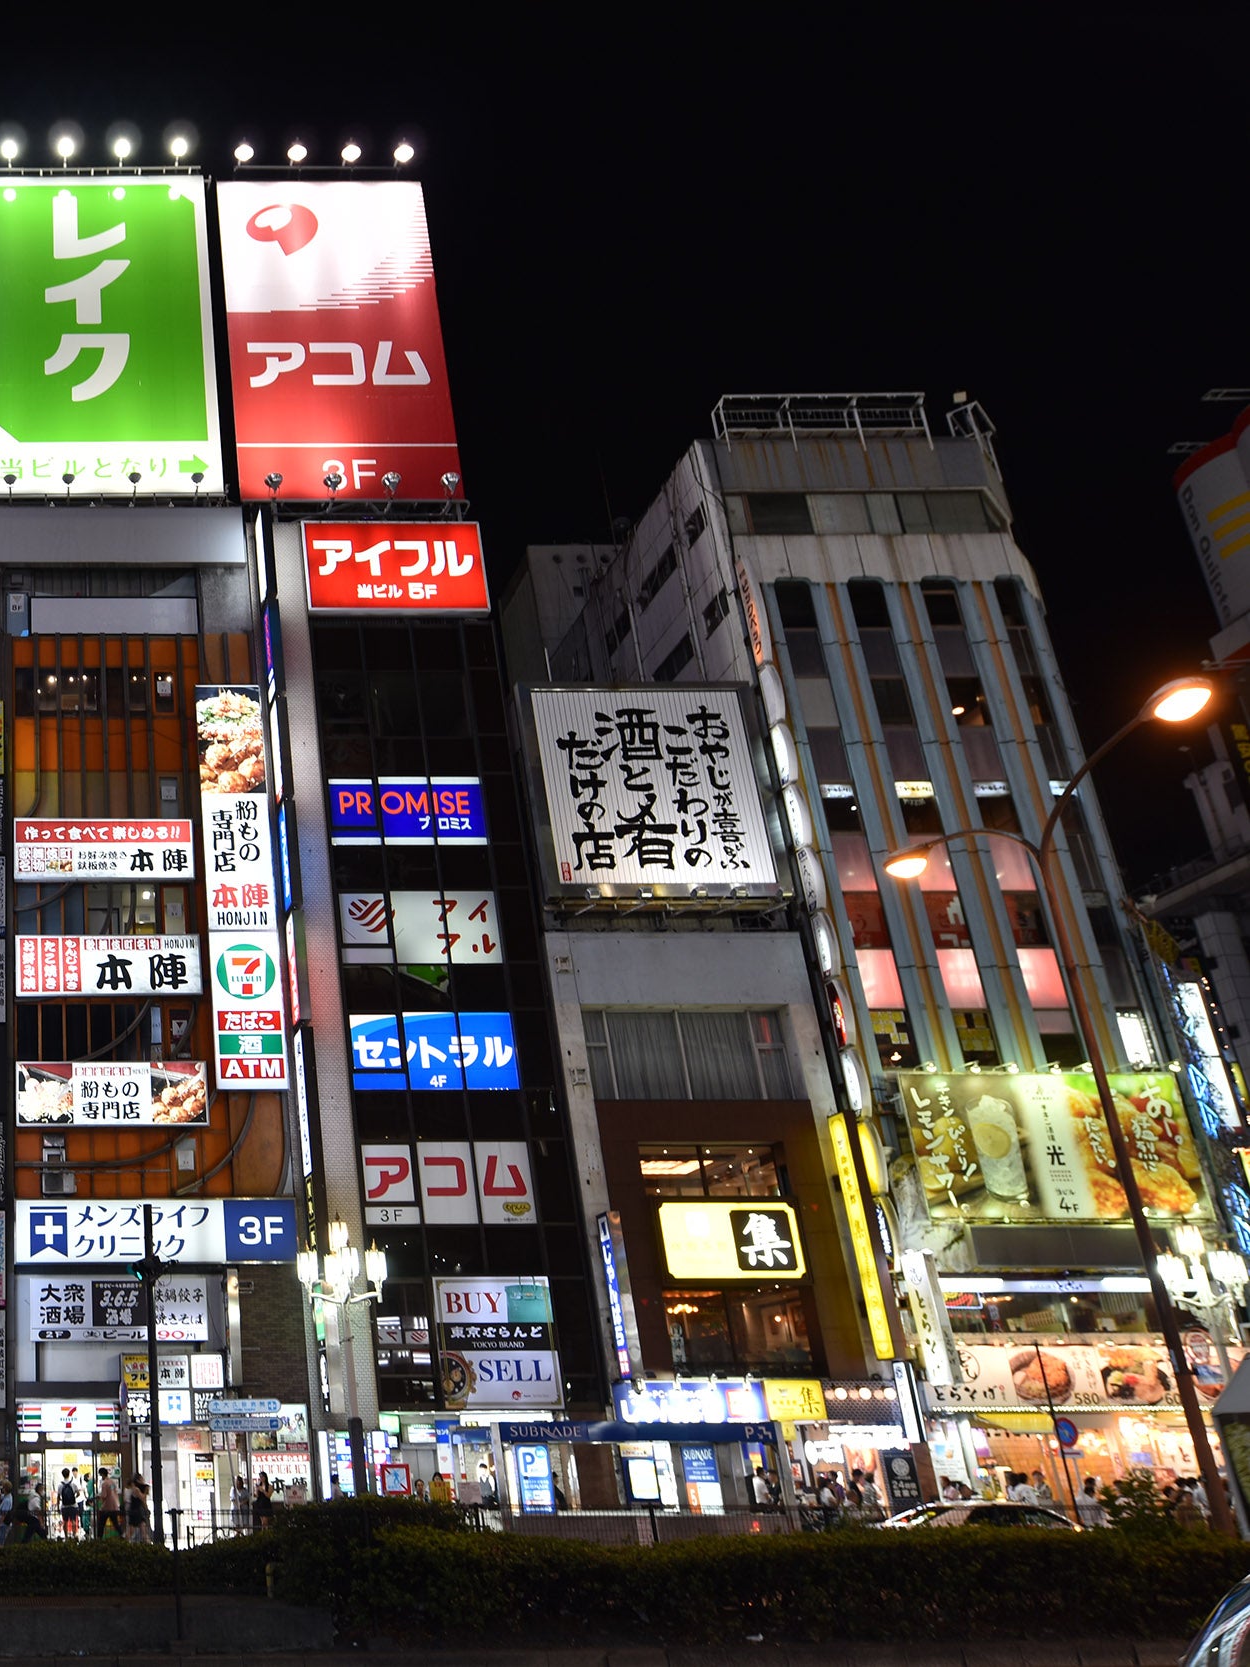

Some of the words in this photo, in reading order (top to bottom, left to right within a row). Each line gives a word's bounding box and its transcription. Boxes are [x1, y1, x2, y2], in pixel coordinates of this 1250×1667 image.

[44, 196, 131, 402] レイク
[247, 341, 431, 388] アコム
[0, 458, 167, 480] 当ビルとなり
[322, 459, 377, 490] 3F
[312, 540, 474, 577] アイフル
[1181, 484, 1205, 532] Don
[1200, 534, 1232, 621] Quijote
[357, 583, 402, 598] 当ビル
[408, 583, 437, 598] 5F
[594, 708, 678, 870] 酒と肴
[663, 725, 713, 868] こだわりの
[686, 705, 750, 870] おやじが喜ぶ
[339, 791, 471, 815] PROMISE
[556, 731, 618, 871] だけの店
[236, 800, 261, 862] 粉もの
[420, 816, 472, 831] プロミス
[212, 809, 237, 873] 専門店
[130, 848, 189, 873] 本陣
[213, 883, 270, 909] 本陣
[217, 911, 268, 926] HONJIN
[432, 899, 489, 923] アイ
[84, 939, 162, 951] 歌舞伎町名物
[164, 939, 196, 950] HONJIN
[43, 940, 58, 990] たこ焼き
[96, 954, 189, 991] 本陣
[225, 1012, 275, 1031] たばこ
[239, 1035, 263, 1055] 酒
[352, 1035, 514, 1068] セントラル
[225, 1059, 281, 1079] ATM
[81, 1081, 140, 1098] 粉もの
[429, 1074, 447, 1089] 4F
[81, 1101, 140, 1119] 専門店
[1046, 1145, 1066, 1166] 光
[364, 1154, 528, 1199] アコム
[380, 1209, 403, 1222] 3F
[1059, 1197, 1080, 1214] 4F
[74, 1205, 210, 1229] メンズライフ
[238, 1216, 284, 1246] 3F
[740, 1213, 792, 1268] 集
[39, 1284, 85, 1303] 大衆
[445, 1291, 502, 1314] BUY
[39, 1305, 86, 1325] 酒場
[45, 1331, 65, 1339] 2F
[472, 1341, 497, 1349] TOKYO
[499, 1341, 525, 1349] BRAND
[478, 1360, 552, 1382] SELL
[799, 1385, 822, 1414] 集
[1074, 1392, 1100, 1404] 580
[510, 1425, 582, 1439] SUBNADE
[744, 1425, 755, 1439] P
[522, 1451, 536, 1473] P
